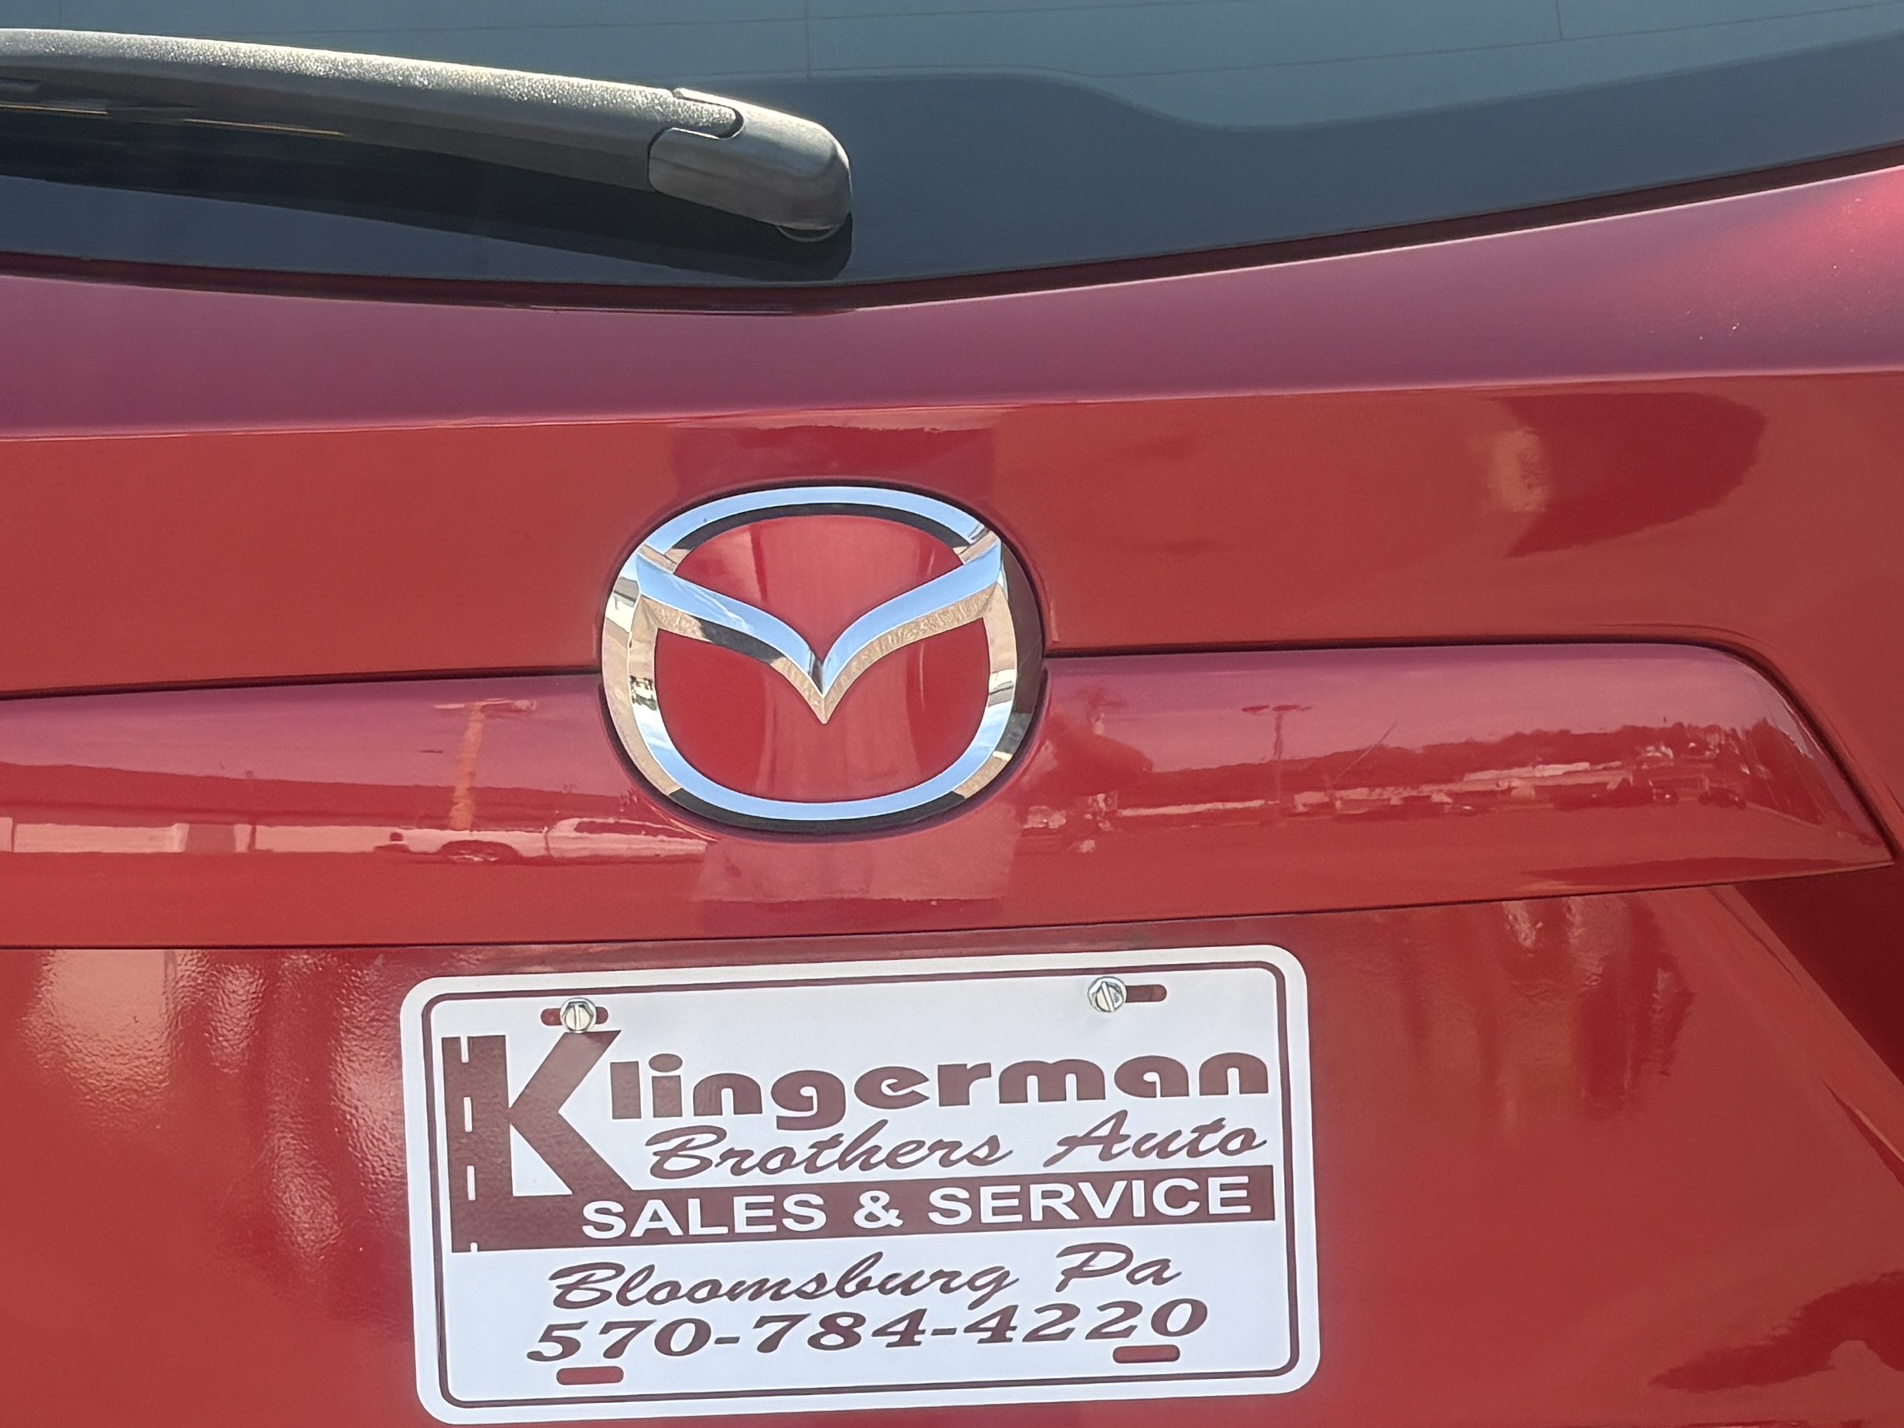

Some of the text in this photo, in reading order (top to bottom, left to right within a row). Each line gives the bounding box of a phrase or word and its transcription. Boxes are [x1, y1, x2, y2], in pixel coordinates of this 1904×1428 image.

[441, 1028, 1270, 1196] Klingerman
[644, 1109, 1269, 1180] Brothers Auto
[580, 1173, 1254, 1240] SALES & SERVICE
[547, 1241, 1184, 1313] Bloomsburg Pa
[525, 1296, 1209, 1364] 570-784-4220
